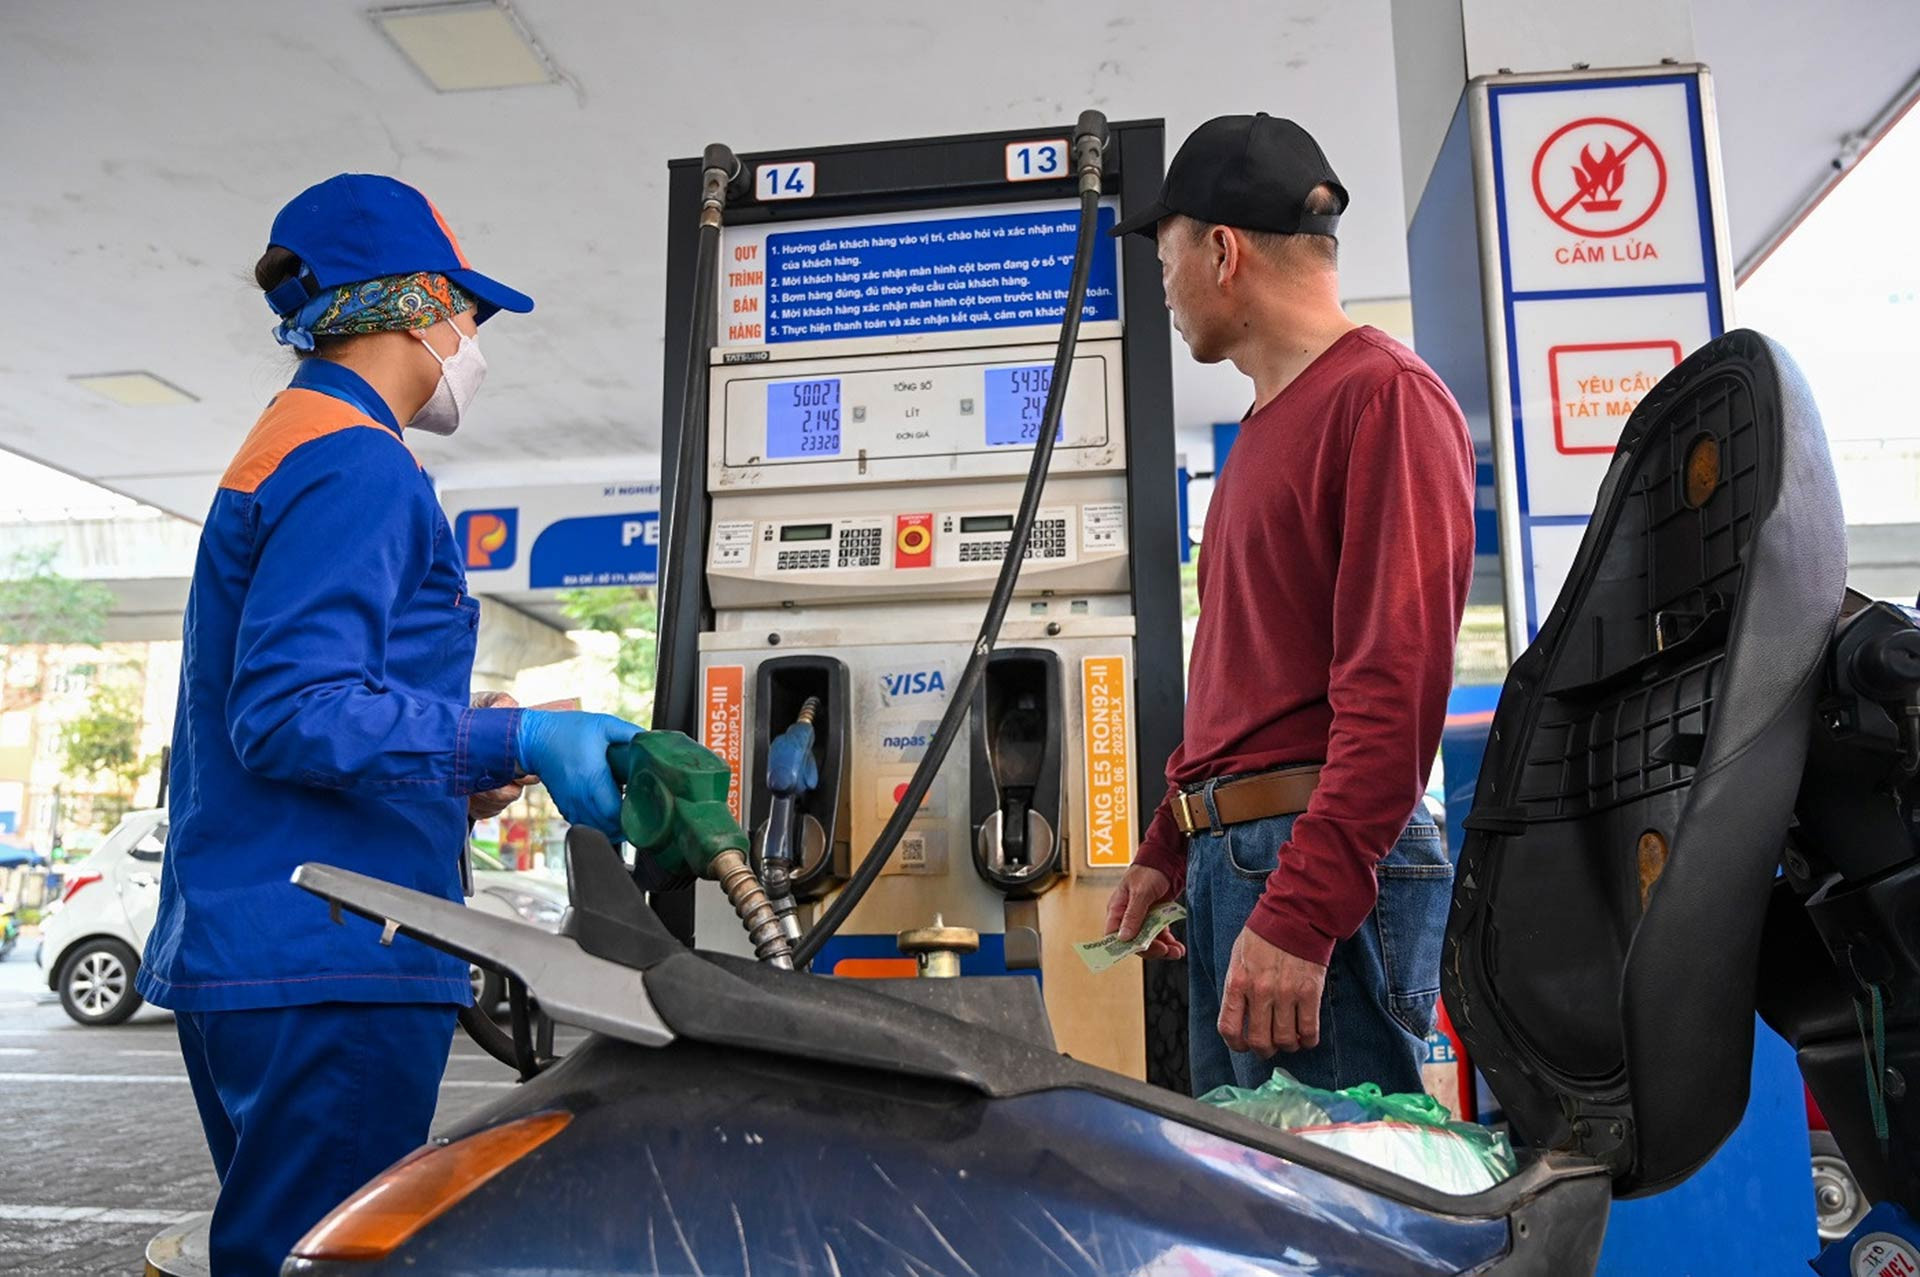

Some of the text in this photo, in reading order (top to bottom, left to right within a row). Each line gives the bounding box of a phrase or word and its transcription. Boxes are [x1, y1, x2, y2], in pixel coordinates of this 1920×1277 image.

[1016, 147, 1058, 176] 13
[765, 167, 805, 196] 14
[840, 238, 870, 250] khách
[872, 236, 897, 248] hàng
[899, 234, 918, 245] vào
[920, 233, 929, 245] vị
[947, 230, 973, 241] chào
[993, 226, 1006, 237] và
[1007, 225, 1026, 236] xác
[1028, 224, 1054, 236] nhận
[1056, 222, 1077, 233] nhu
[735, 245, 758, 262] QUY
[782, 256, 862, 271] của khách hàng.
[1555, 237, 1658, 265] CẤM LỬA
[729, 270, 764, 288] TRÌNH
[770, 277, 780, 288] 2.
[782, 275, 801, 287] Mời
[803, 273, 833, 285] khách
[834, 271, 860, 283] hàng
[862, 269, 880, 280] xác
[882, 267, 908, 280] nhận
[909, 265, 932, 277] màn
[933, 263, 957, 275] hình
[959, 262, 975, 275] cột
[977, 261, 1001, 272] bơm
[1003, 258, 1029, 271] đang
[1042, 254, 1055, 266] số
[770, 293, 780, 304] 3.
[782, 291, 806, 303] Bơm
[808, 290, 833, 302] hàng
[881, 284, 904, 296] theo
[906, 282, 925, 296] yêu
[926, 279, 945, 292] cầu
[947, 279, 966, 290] của
[968, 276, 999, 288] khách
[1001, 275, 1030, 288] hàng.
[733, 296, 758, 314] BÁN
[770, 286, 1113, 320] 4. Mời khách hàng xác nhận màn hình cột bơm trước khi tha toán.
[729, 322, 761, 340] HÀNG
[770, 325, 780, 336] 5.
[782, 323, 808, 336] Thực
[809, 321, 831, 335] hiện
[833, 319, 862, 331] thanh
[864, 318, 887, 330] toán
[889, 316, 901, 328] và
[903, 315, 921, 327] xác
[923, 313, 949, 327] nhận
[951, 310, 967, 323] kết
[1018, 308, 1033, 319] ơn
[1035, 306, 1066, 318] khách
[1082, 305, 1099, 317] ng.
[1011, 369, 1049, 393] 5436
[1577, 375, 1615, 394] YÊU
[793, 383, 840, 407] 50021
[1606, 397, 1638, 417] MÁ
[802, 408, 839, 433] 2.145
[801, 434, 839, 451] 23320
[882, 670, 945, 696] VISA
[729, 704, 740, 760] 2023/PLX
[1111, 697, 1124, 755] 2023/PLX
[883, 736, 925, 749] napas
[1090, 665, 1113, 856] XĂNG E5 RON92-II
[1113, 767, 1125, 782] 06
[727, 789, 739, 817] CCS
[1113, 786, 1126, 822] TCCS
